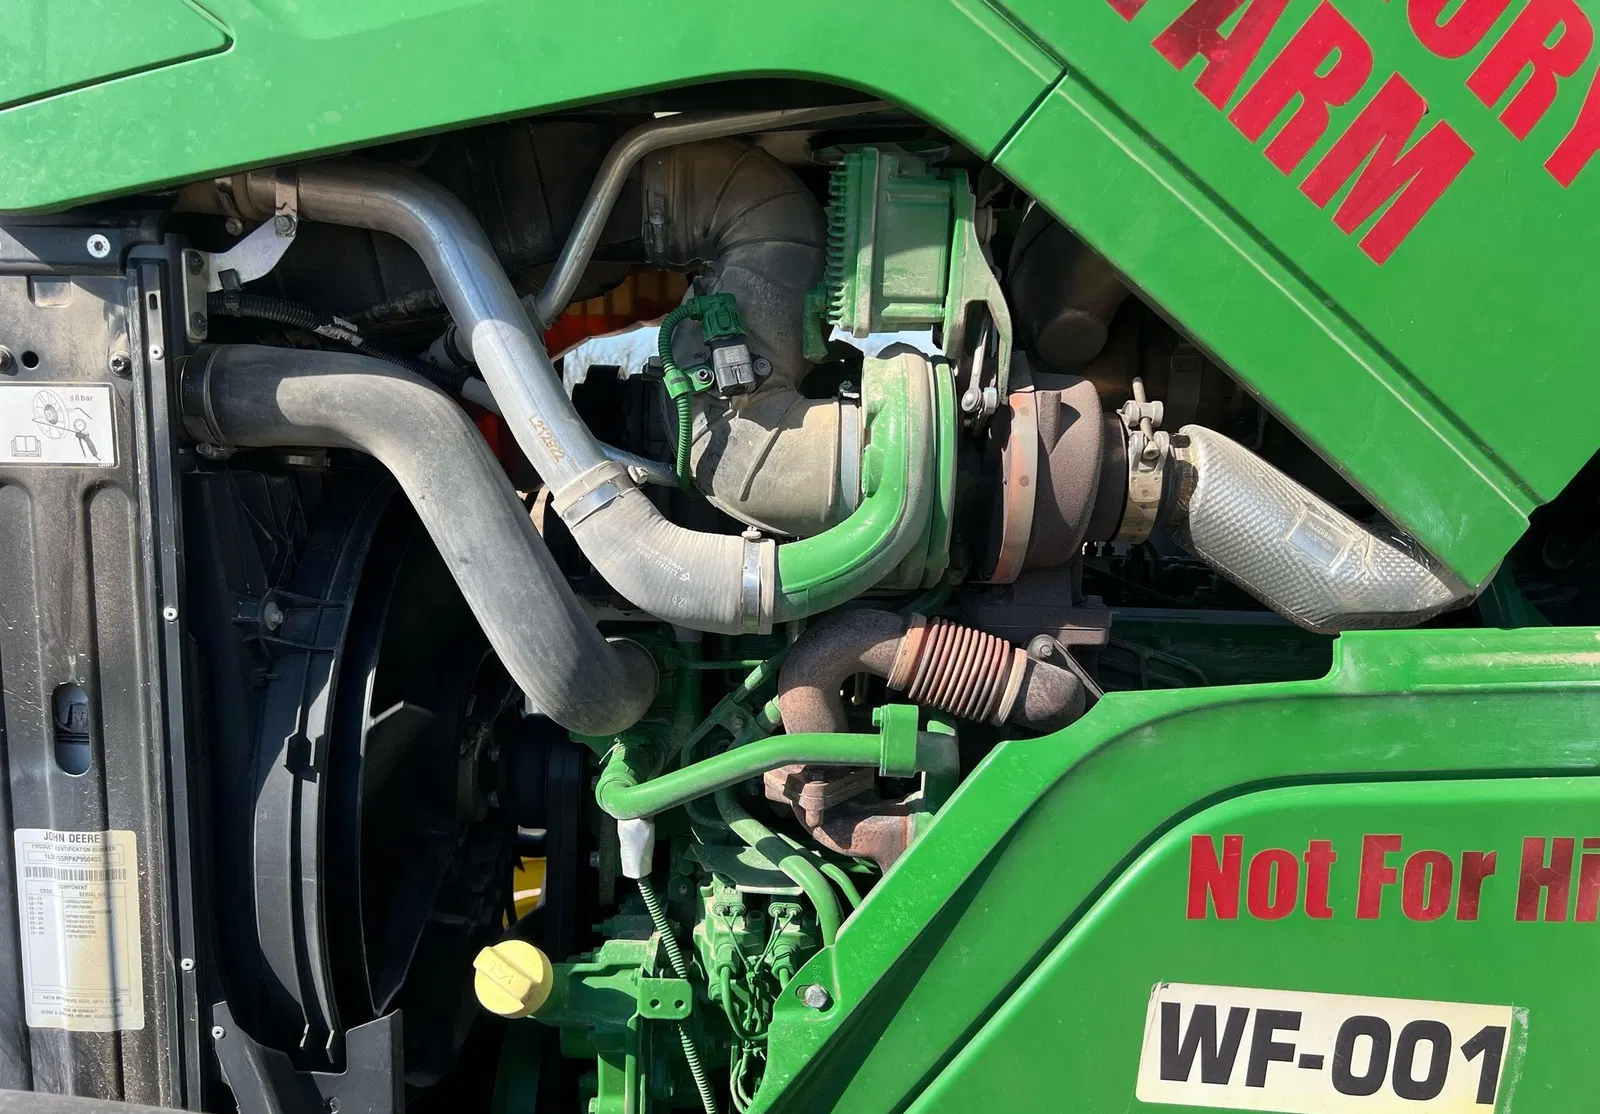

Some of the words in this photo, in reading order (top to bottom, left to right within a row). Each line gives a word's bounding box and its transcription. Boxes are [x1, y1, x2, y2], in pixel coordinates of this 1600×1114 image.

[1110, 0, 1476, 267] ARM
[43, 831, 65, 843] JOHN
[69, 833, 101, 844] DEERE
[1186, 834, 1337, 921] Not
[1355, 834, 1497, 922] For
[1159, 1001, 1508, 1105] WF-001
